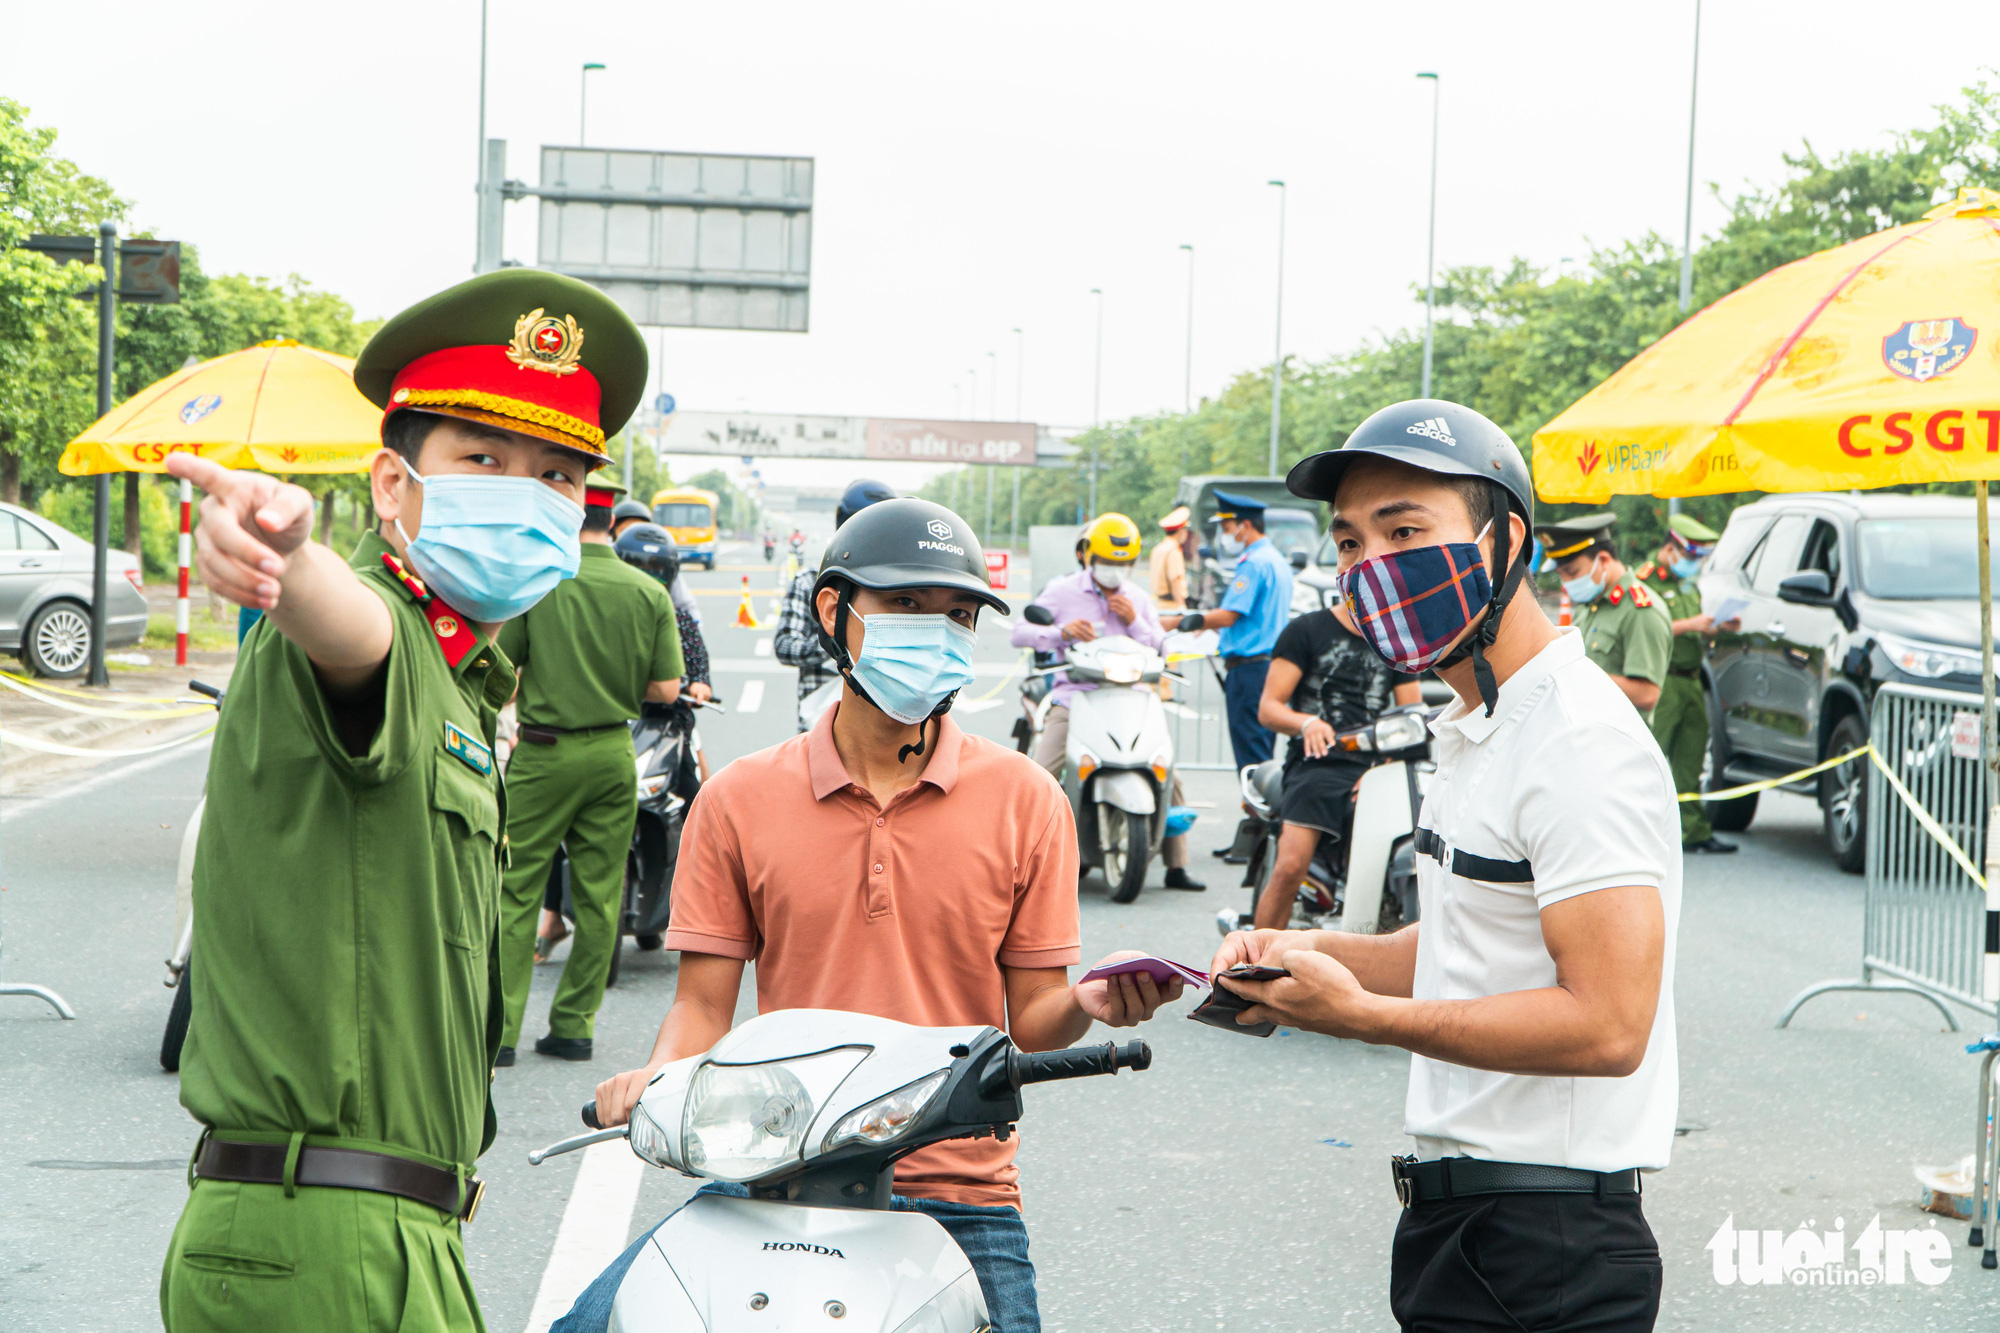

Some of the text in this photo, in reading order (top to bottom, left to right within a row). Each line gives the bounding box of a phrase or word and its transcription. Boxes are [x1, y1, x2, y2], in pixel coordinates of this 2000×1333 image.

[1406, 425, 1457, 447] adidas
[1838, 409, 2000, 459] CSGT
[917, 540, 965, 556] PIAGGIO
[761, 1242, 847, 1260] HONDA
